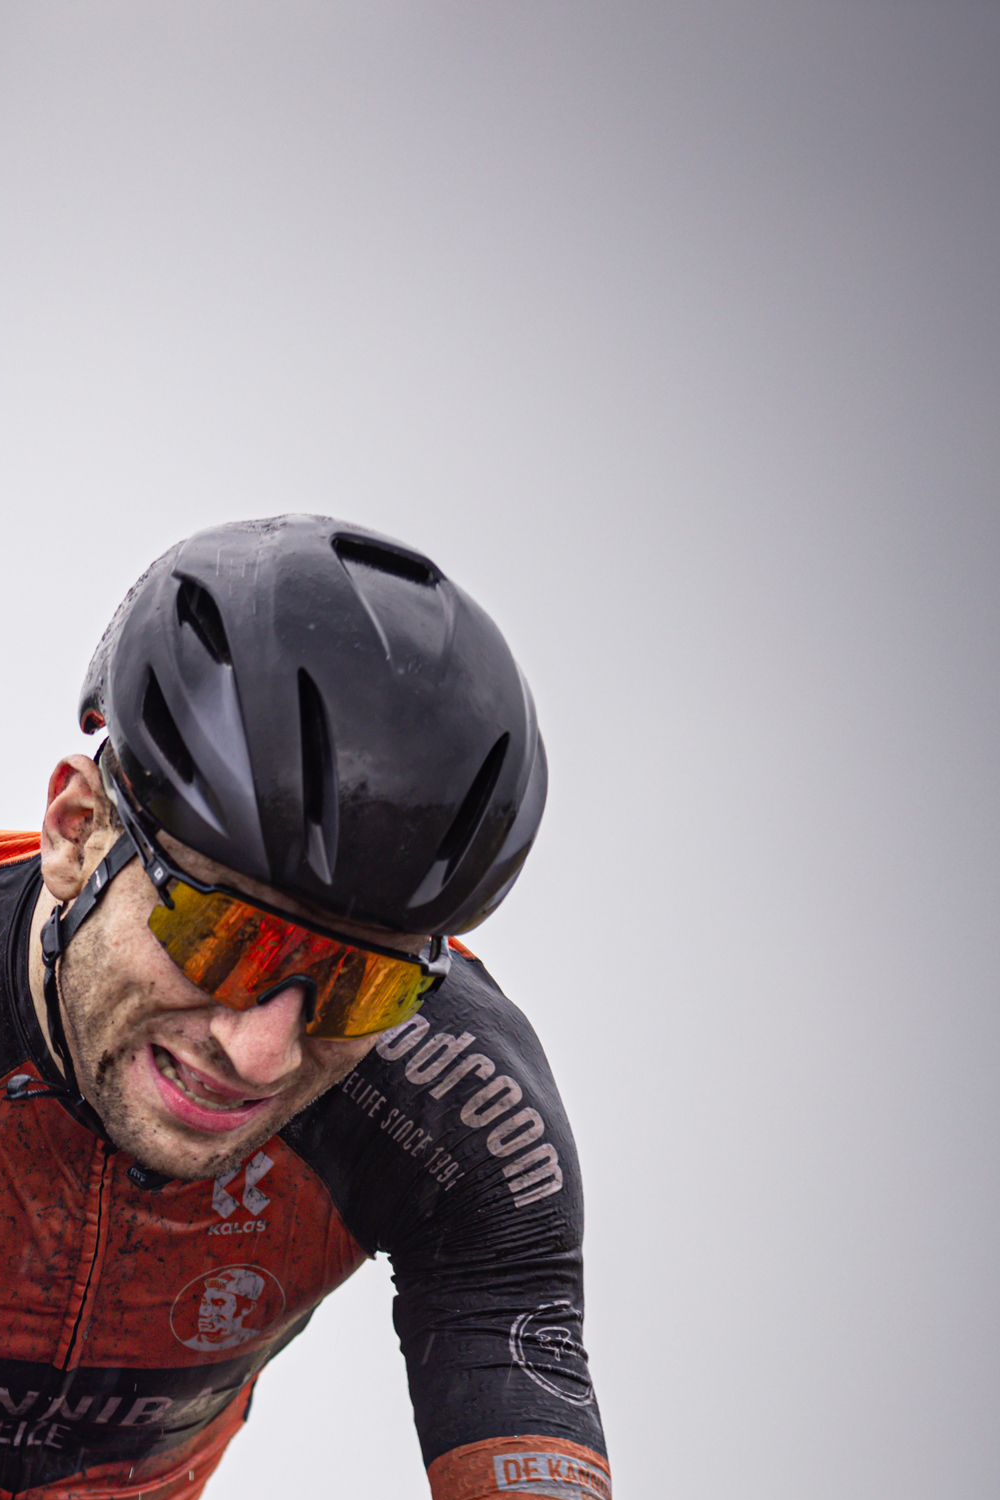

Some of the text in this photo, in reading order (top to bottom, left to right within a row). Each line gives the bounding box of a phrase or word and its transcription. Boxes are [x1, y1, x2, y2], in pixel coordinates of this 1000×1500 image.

[339, 1070, 388, 1119] ELIFE
[381, 1107, 434, 1158] SINCE
[376, 1013, 564, 1209] odroom
[503, 1457, 543, 1485] DE
